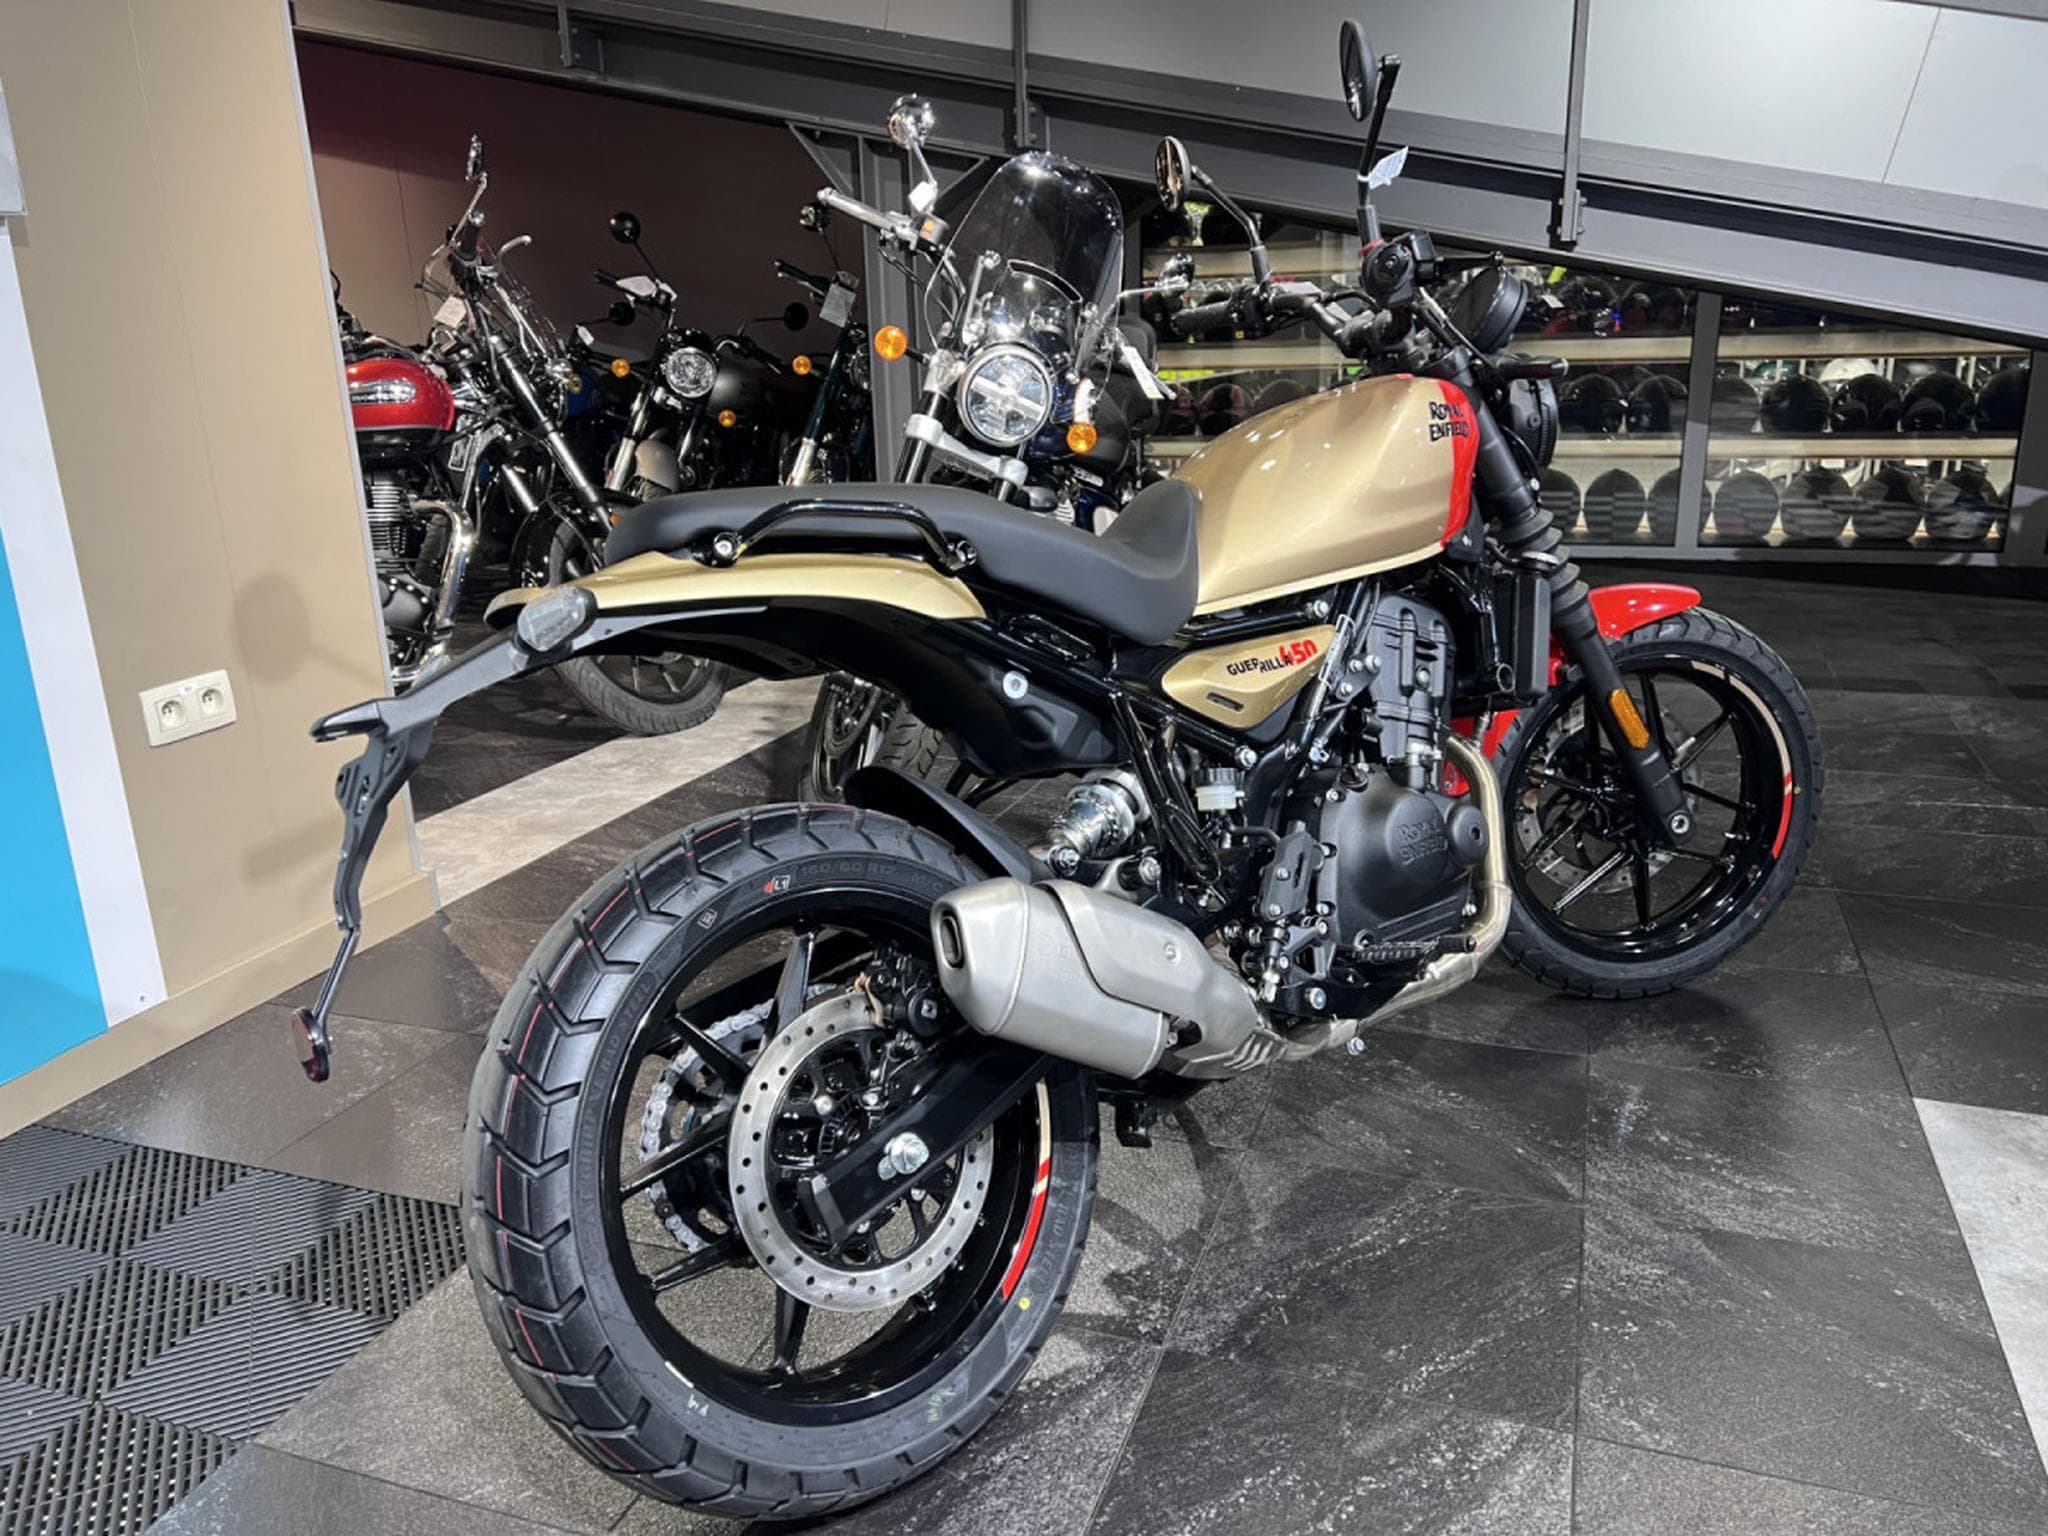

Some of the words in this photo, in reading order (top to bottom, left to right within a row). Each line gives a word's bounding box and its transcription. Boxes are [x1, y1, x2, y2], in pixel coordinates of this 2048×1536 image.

[1428, 401, 1463, 420] ROYAL
[1428, 421, 1469, 442] ENFIELD
[1278, 639, 1318, 666] 450
